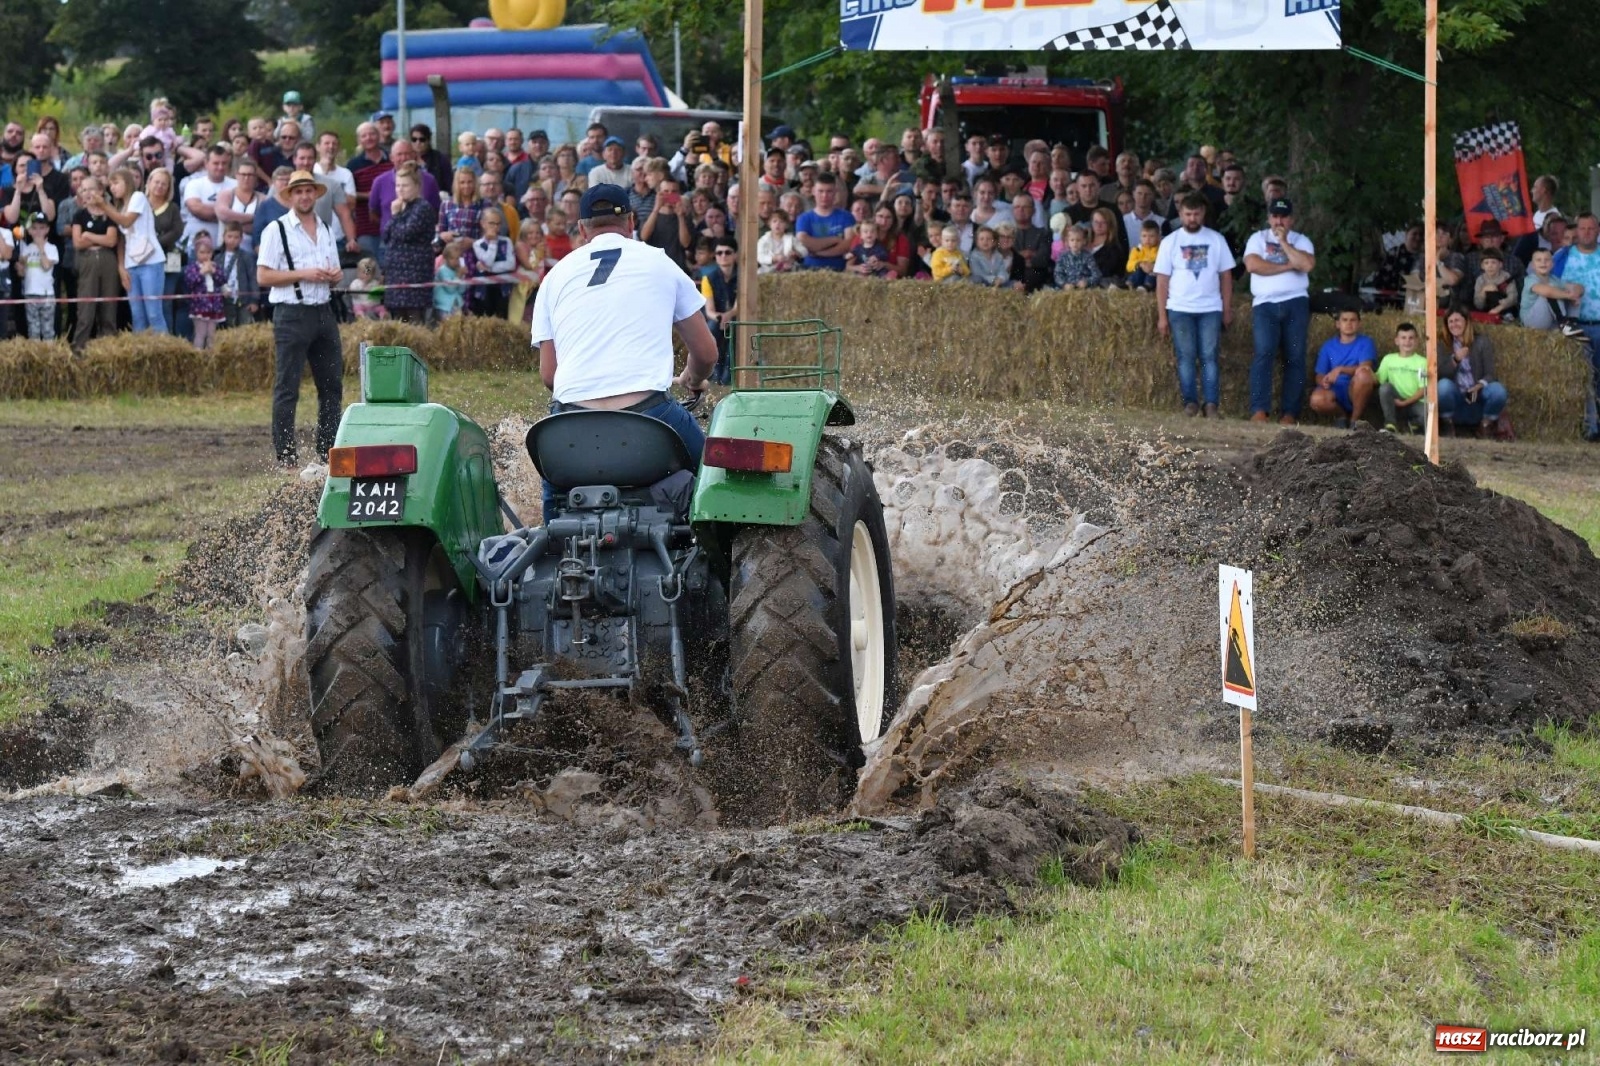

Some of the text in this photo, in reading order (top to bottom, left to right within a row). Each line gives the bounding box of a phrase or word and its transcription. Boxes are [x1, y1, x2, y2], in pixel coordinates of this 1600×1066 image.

[586, 247, 622, 288] 7
[355, 482, 396, 497] KAH
[350, 500, 400, 516] 2042
